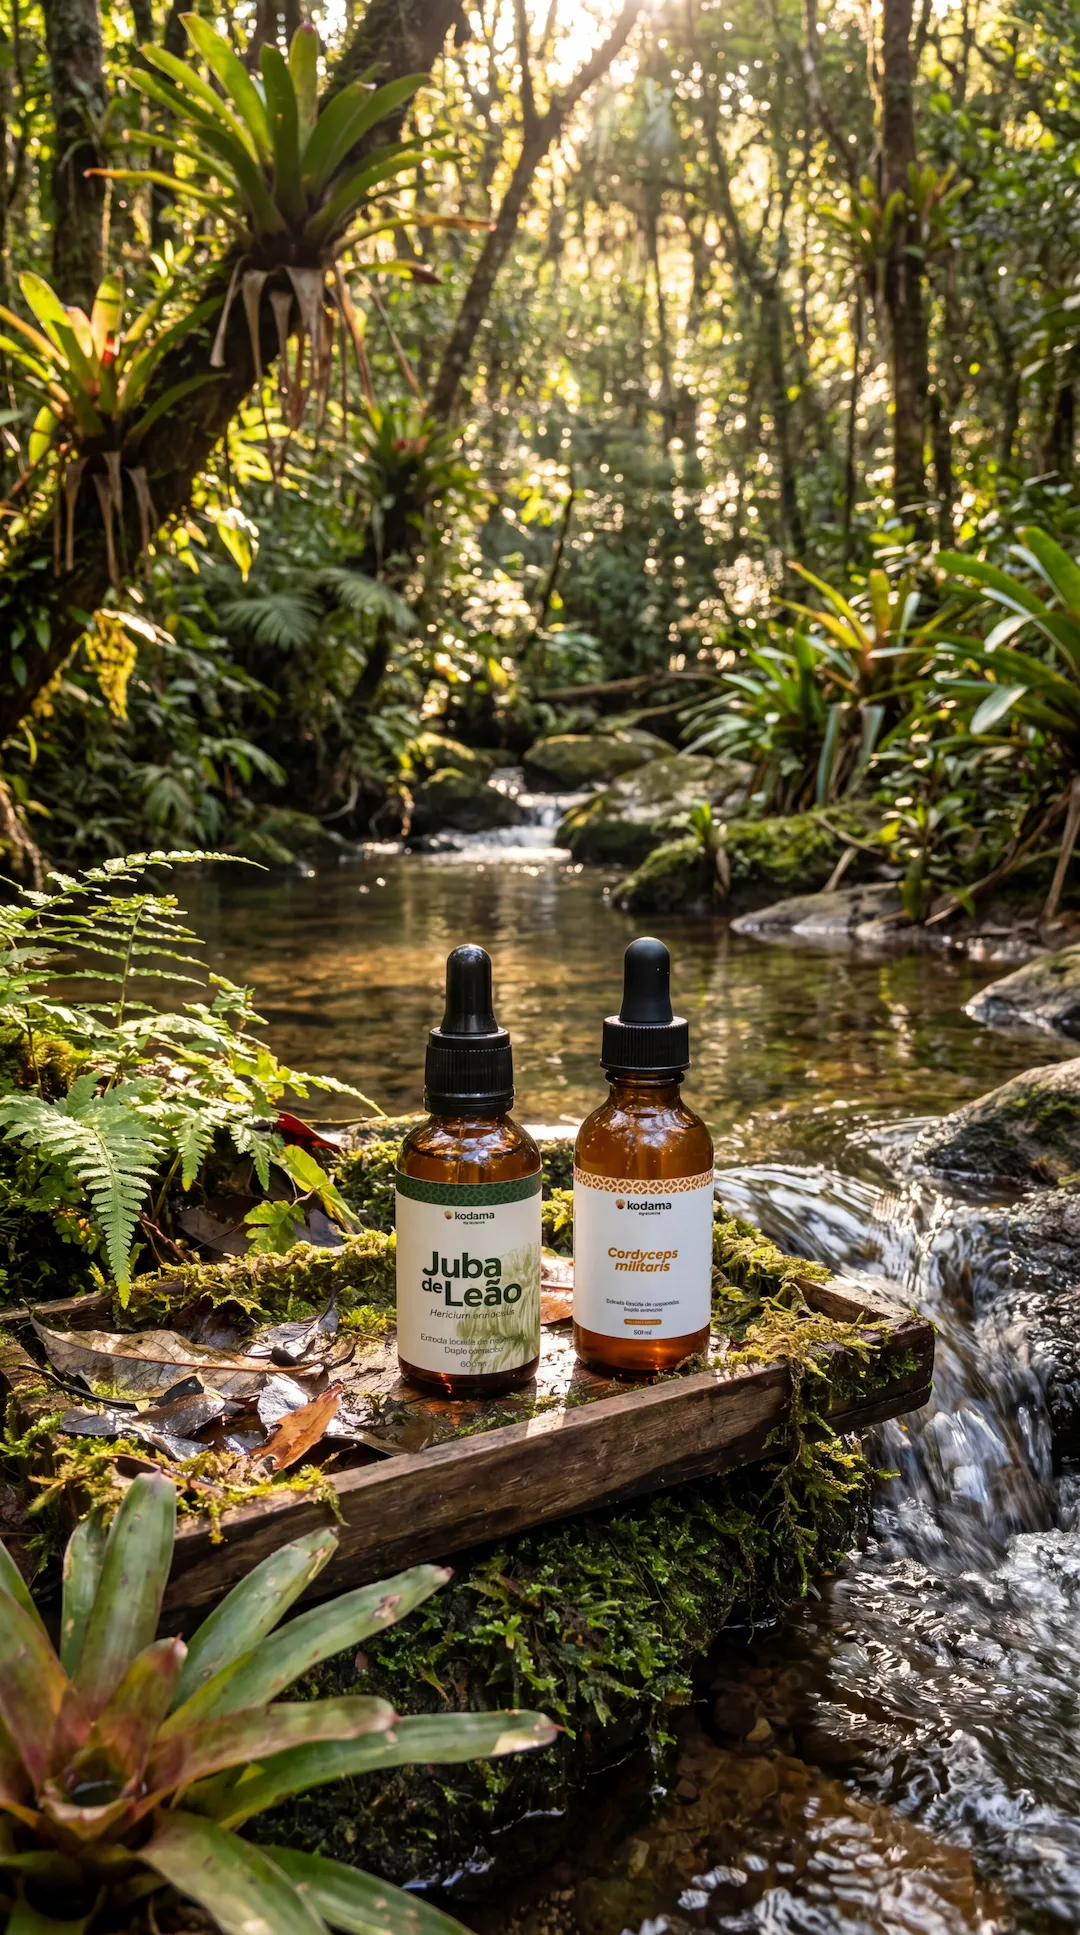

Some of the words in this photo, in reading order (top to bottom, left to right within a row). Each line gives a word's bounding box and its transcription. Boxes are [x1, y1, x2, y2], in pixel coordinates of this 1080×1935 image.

[627, 1200, 672, 1210] kodama
[454, 1211, 495, 1220] kodama
[607, 1247, 679, 1262] Cordyceps
[421, 1251, 502, 1279] Juba
[614, 1260, 671, 1273] militaris
[421, 1277, 443, 1294] de
[445, 1278, 522, 1308] Leão
[429, 1308, 471, 1320] Hericium
